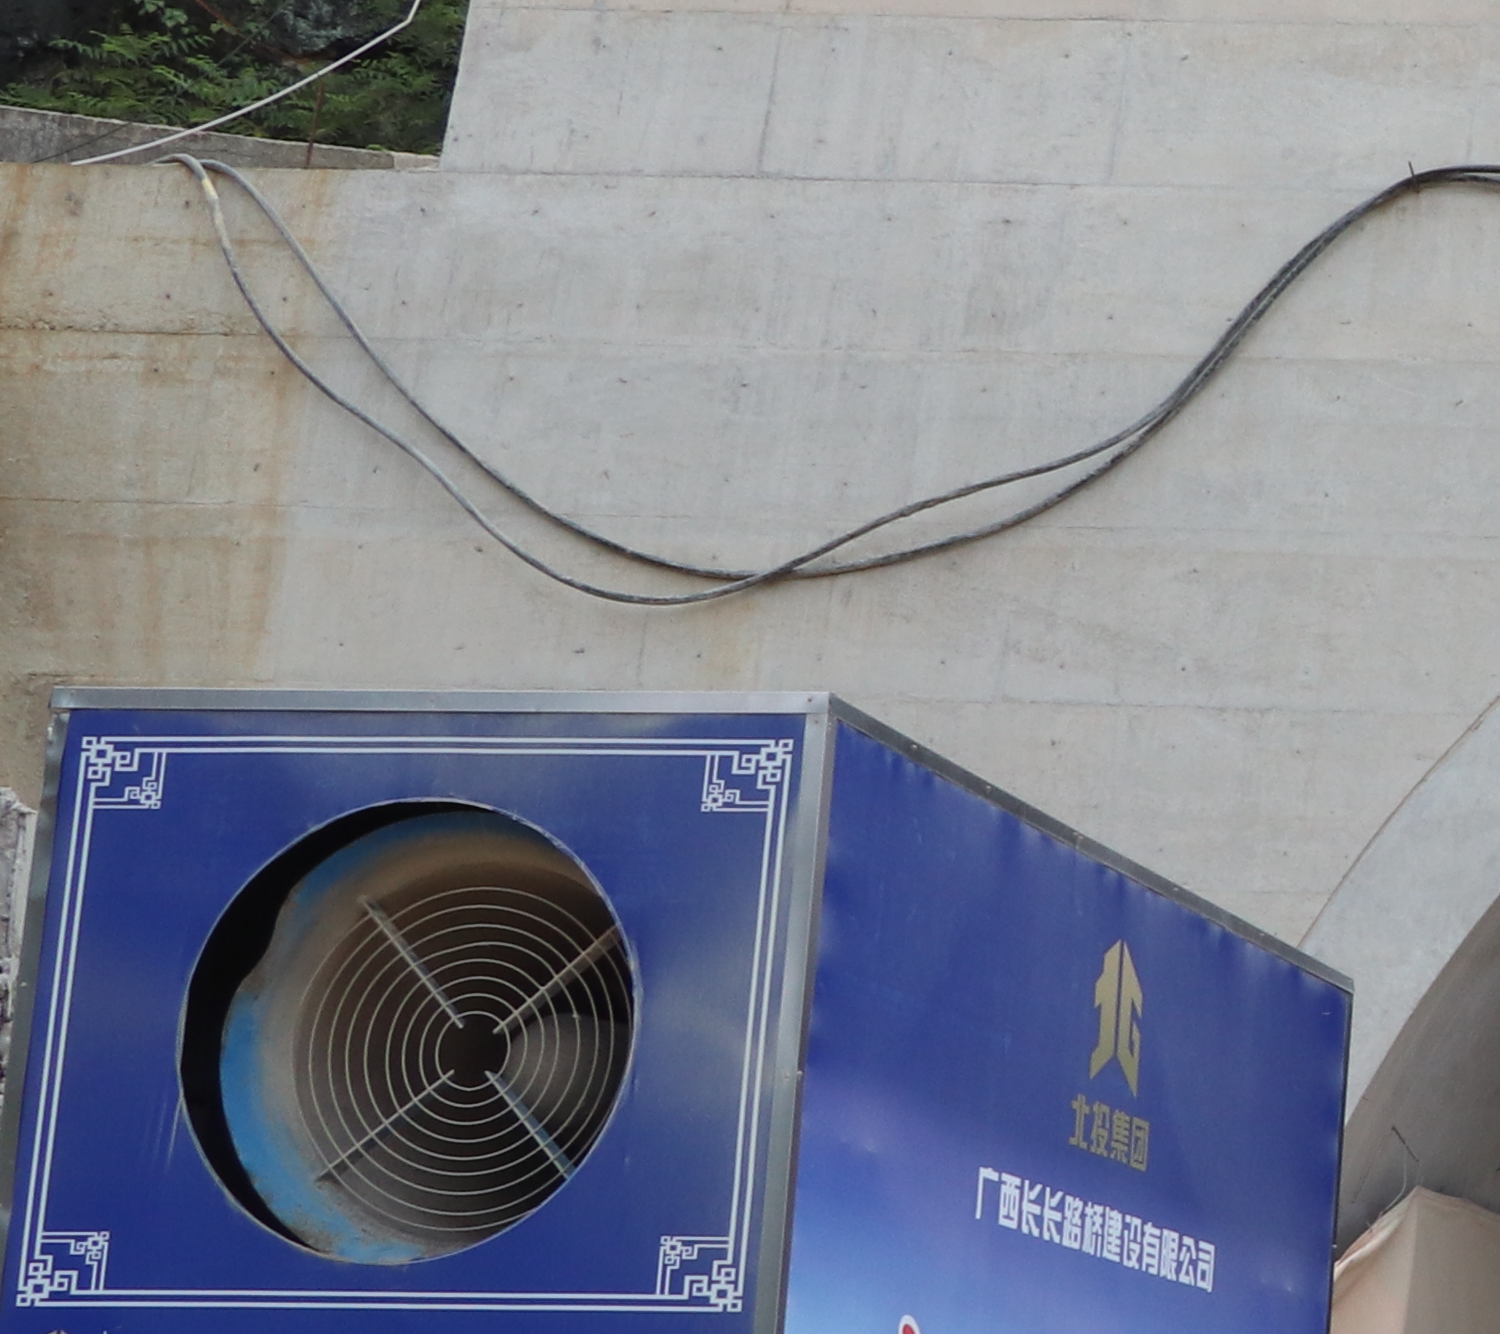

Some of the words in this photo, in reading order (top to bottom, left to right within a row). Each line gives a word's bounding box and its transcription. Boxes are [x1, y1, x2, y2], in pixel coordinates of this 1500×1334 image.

[1068, 1093, 1150, 1173] 北投集团
[974, 1165, 1217, 1294] 广西长长路桥建设有限公司
